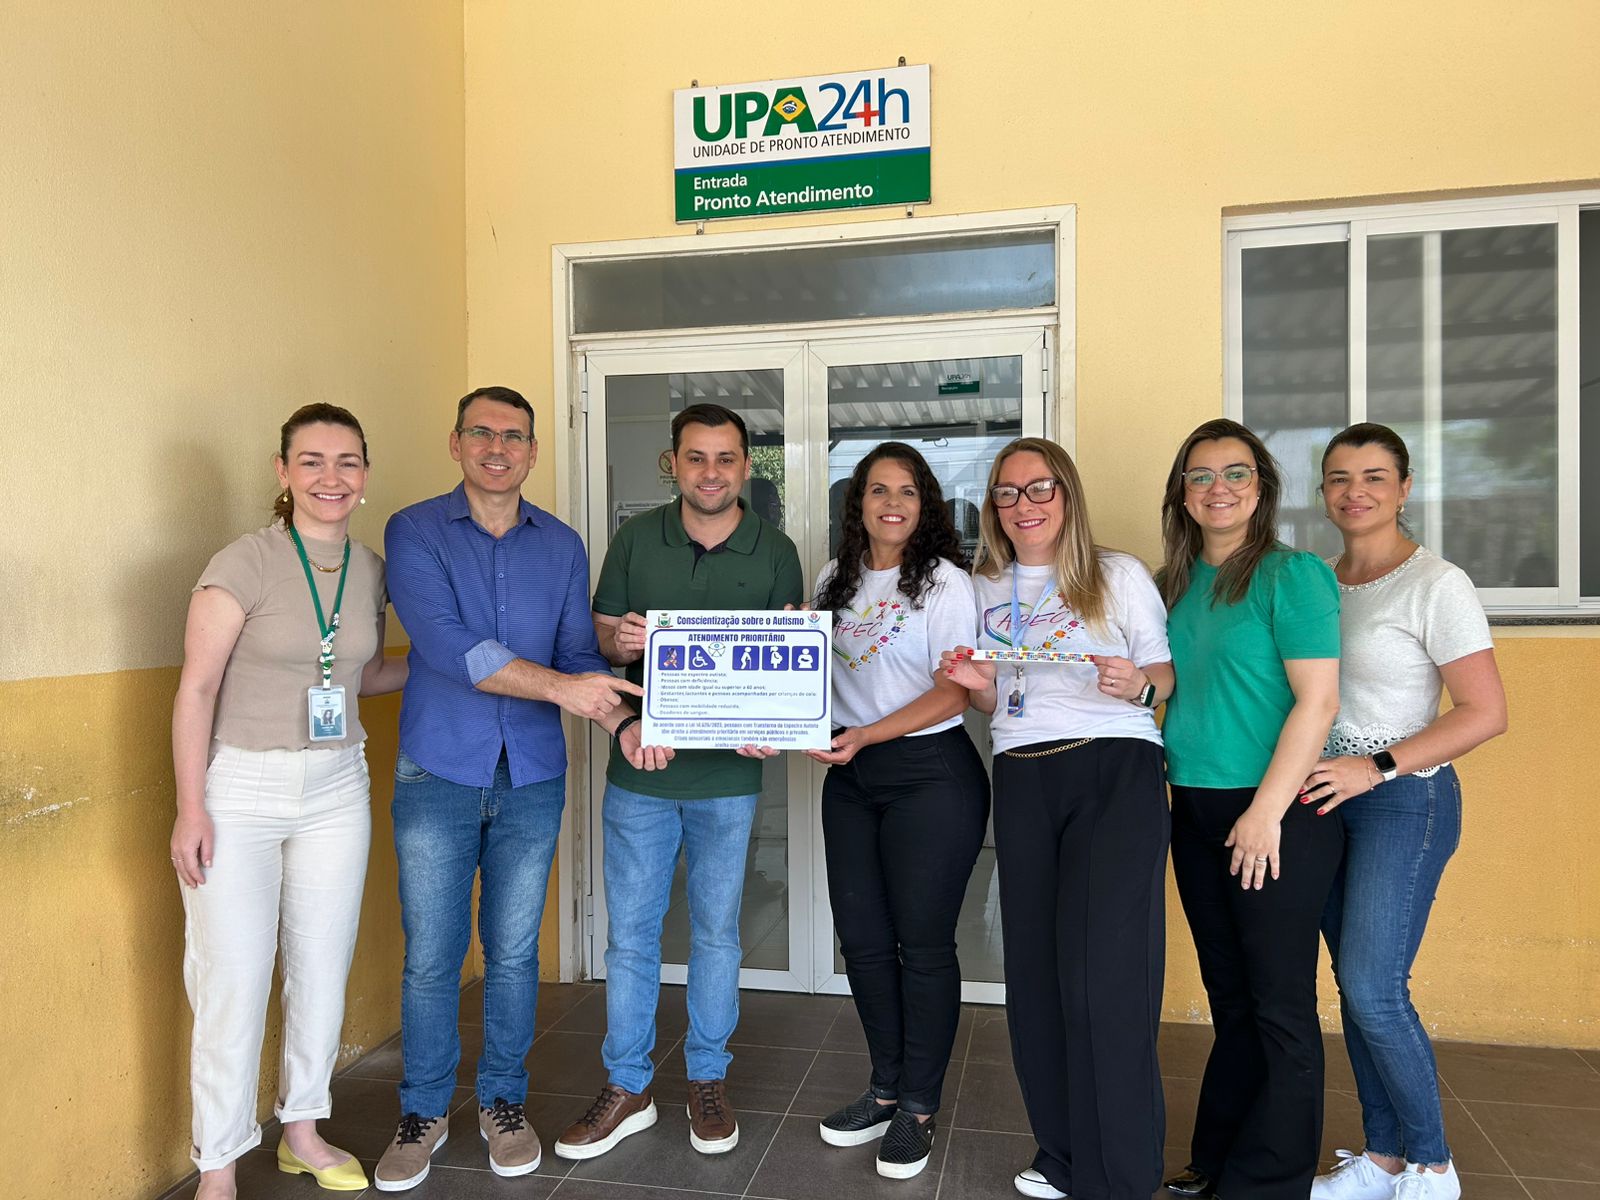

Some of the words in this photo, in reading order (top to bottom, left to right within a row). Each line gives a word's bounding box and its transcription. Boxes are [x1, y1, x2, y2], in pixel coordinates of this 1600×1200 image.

[693, 86, 817, 143] UPA
[817, 77, 910, 132] 24h
[693, 141, 747, 158] UNIDADE
[750, 140, 766, 154] DE
[769, 134, 818, 152] PRONTO
[821, 126, 911, 147] ATENDIMENTO
[693, 173, 748, 190] Entrada
[693, 194, 752, 212] Pronto
[756, 183, 873, 208] Atendimento
[676, 615, 740, 628] Conscientização
[741, 616, 765, 626] sobre
[765, 618, 772, 626] o
[772, 616, 805, 626] Autismo
[688, 634, 739, 642] ATENDIMENTO
[740, 632, 786, 642] PRIORITÁRIO
